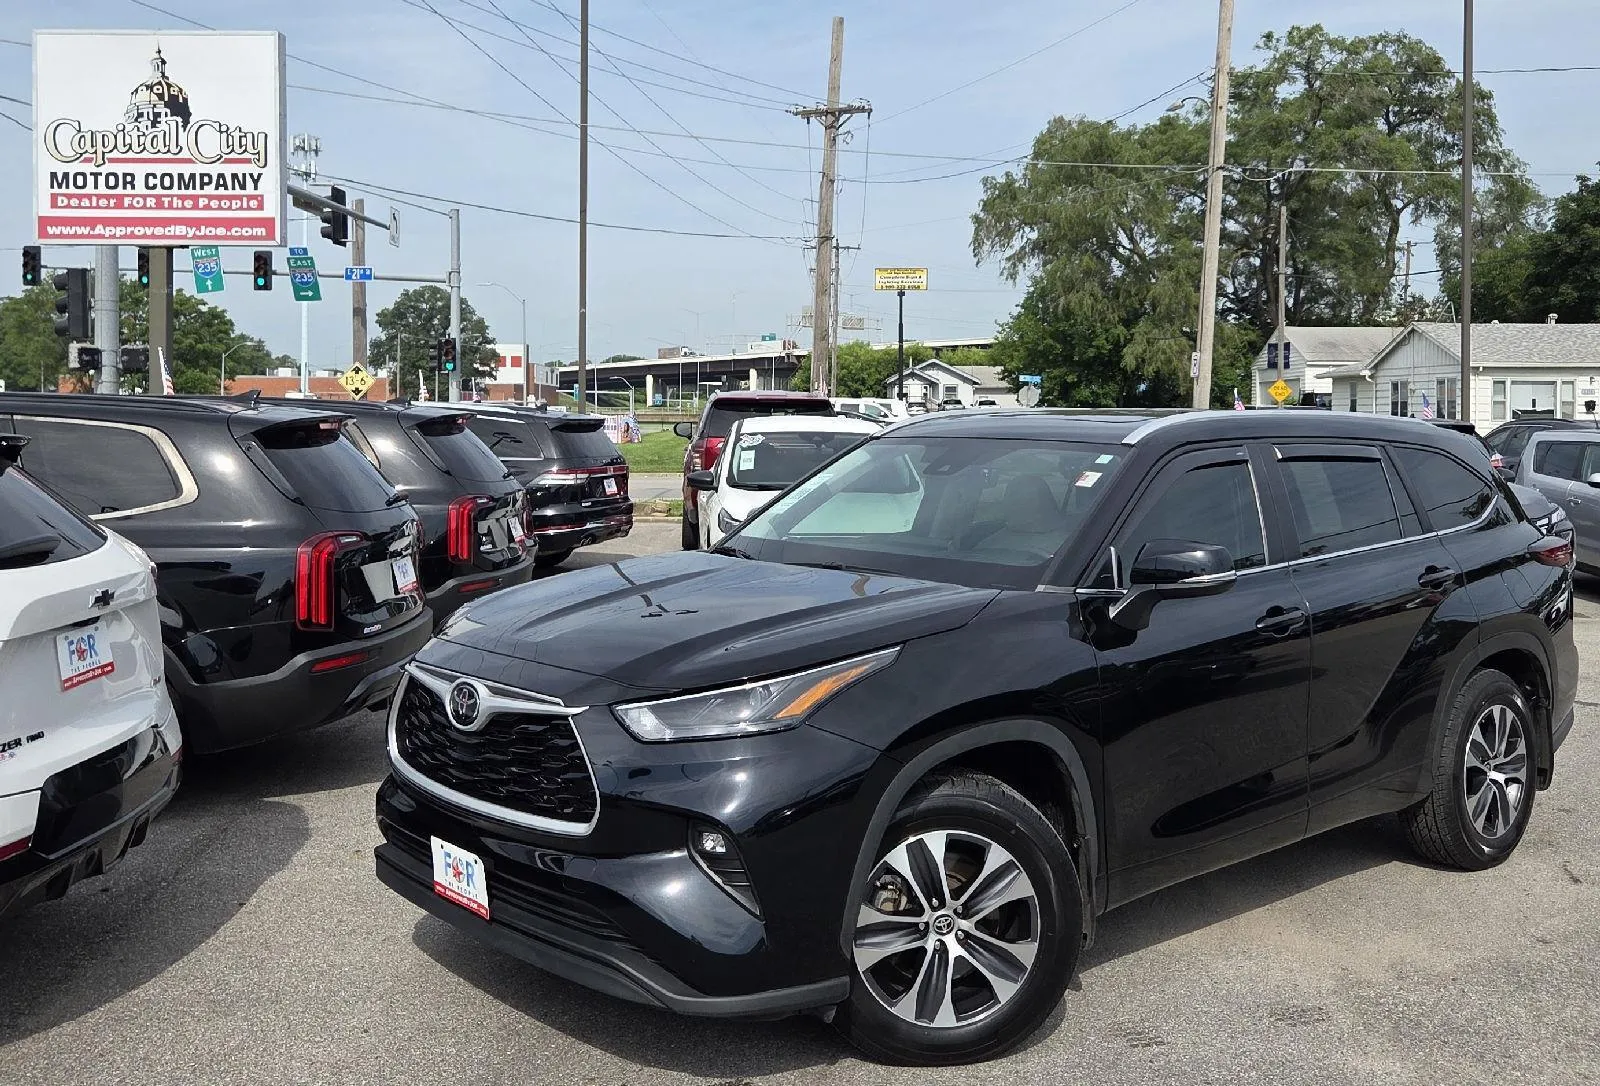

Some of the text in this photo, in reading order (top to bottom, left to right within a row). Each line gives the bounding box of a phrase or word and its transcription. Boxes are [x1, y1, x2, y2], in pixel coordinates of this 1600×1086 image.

[44, 118, 268, 168] Capital City
[50, 172, 263, 191] MOTOR COMPANY
[57, 196, 258, 210] Dealer FOR The People
[46, 224, 266, 239] www.ApprovedByJoe.com
[193, 248, 216, 258] WEST
[197, 262, 217, 273] 235
[289, 258, 312, 267] EAST
[295, 272, 314, 282] 235
[67, 634, 99, 666] FOR
[443, 850, 478, 891] FOR
